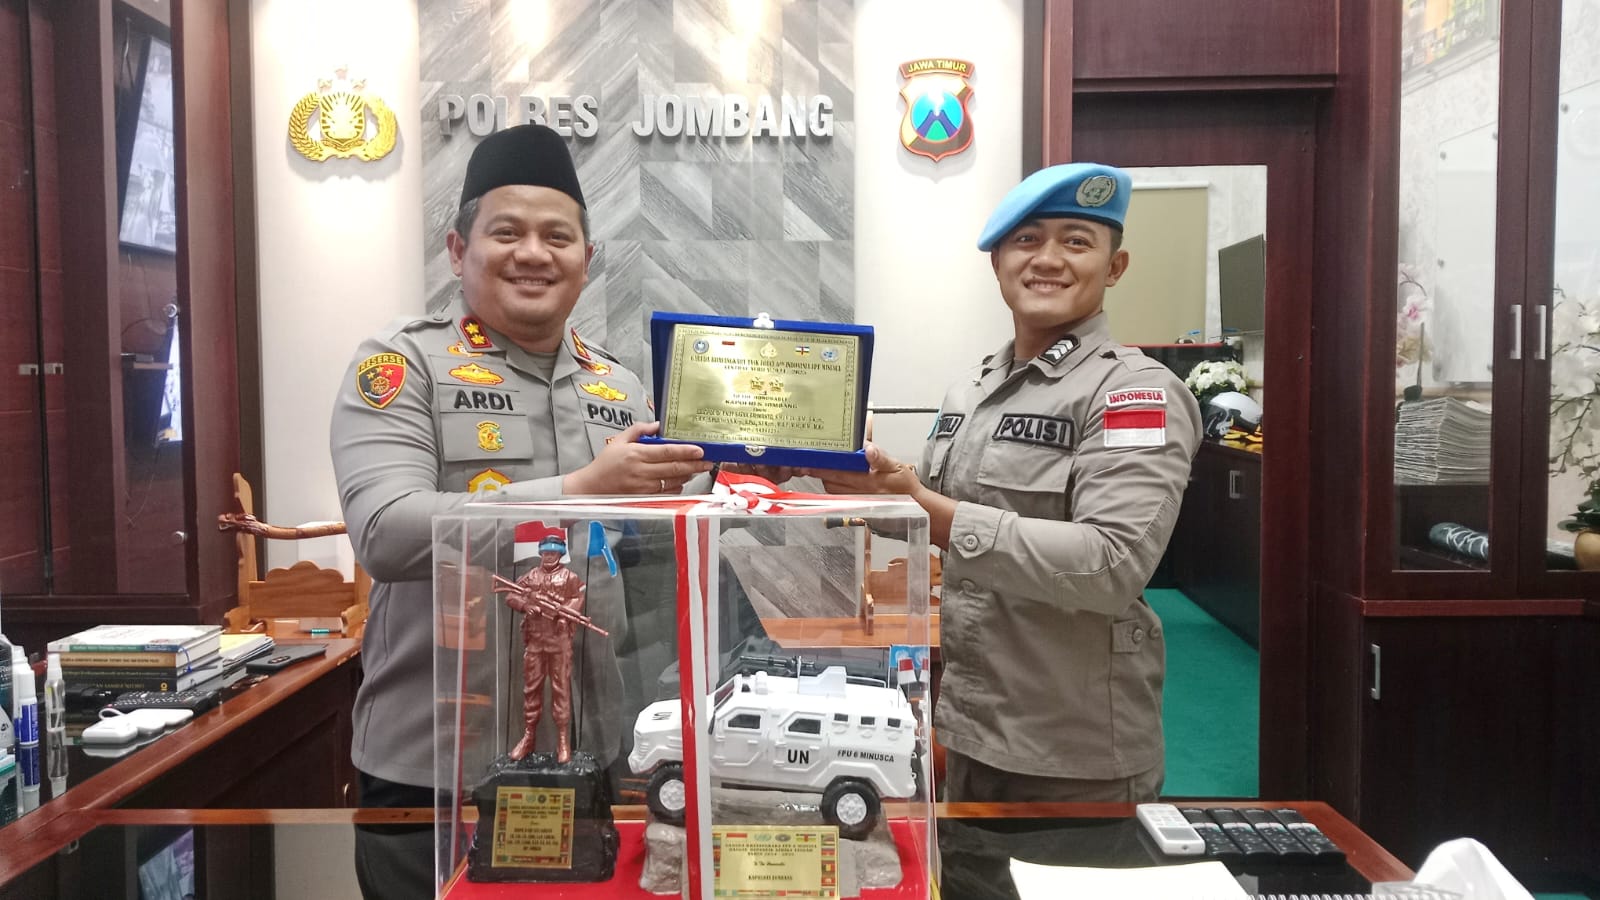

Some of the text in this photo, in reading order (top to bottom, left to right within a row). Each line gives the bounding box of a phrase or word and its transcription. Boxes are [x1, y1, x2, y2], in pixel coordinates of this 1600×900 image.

[908, 59, 967, 73] JAWA TIMUR
[439, 93, 834, 138] POLRES JOMBANG
[360, 355, 403, 371] RESERSE
[453, 390, 514, 411] ARDI
[1108, 391, 1164, 404] INDONESIA
[587, 403, 634, 427] POLRI
[1000, 417, 1068, 444] POLISI
[787, 749, 810, 764] UN
[860, 751, 895, 762] MINUSCA
